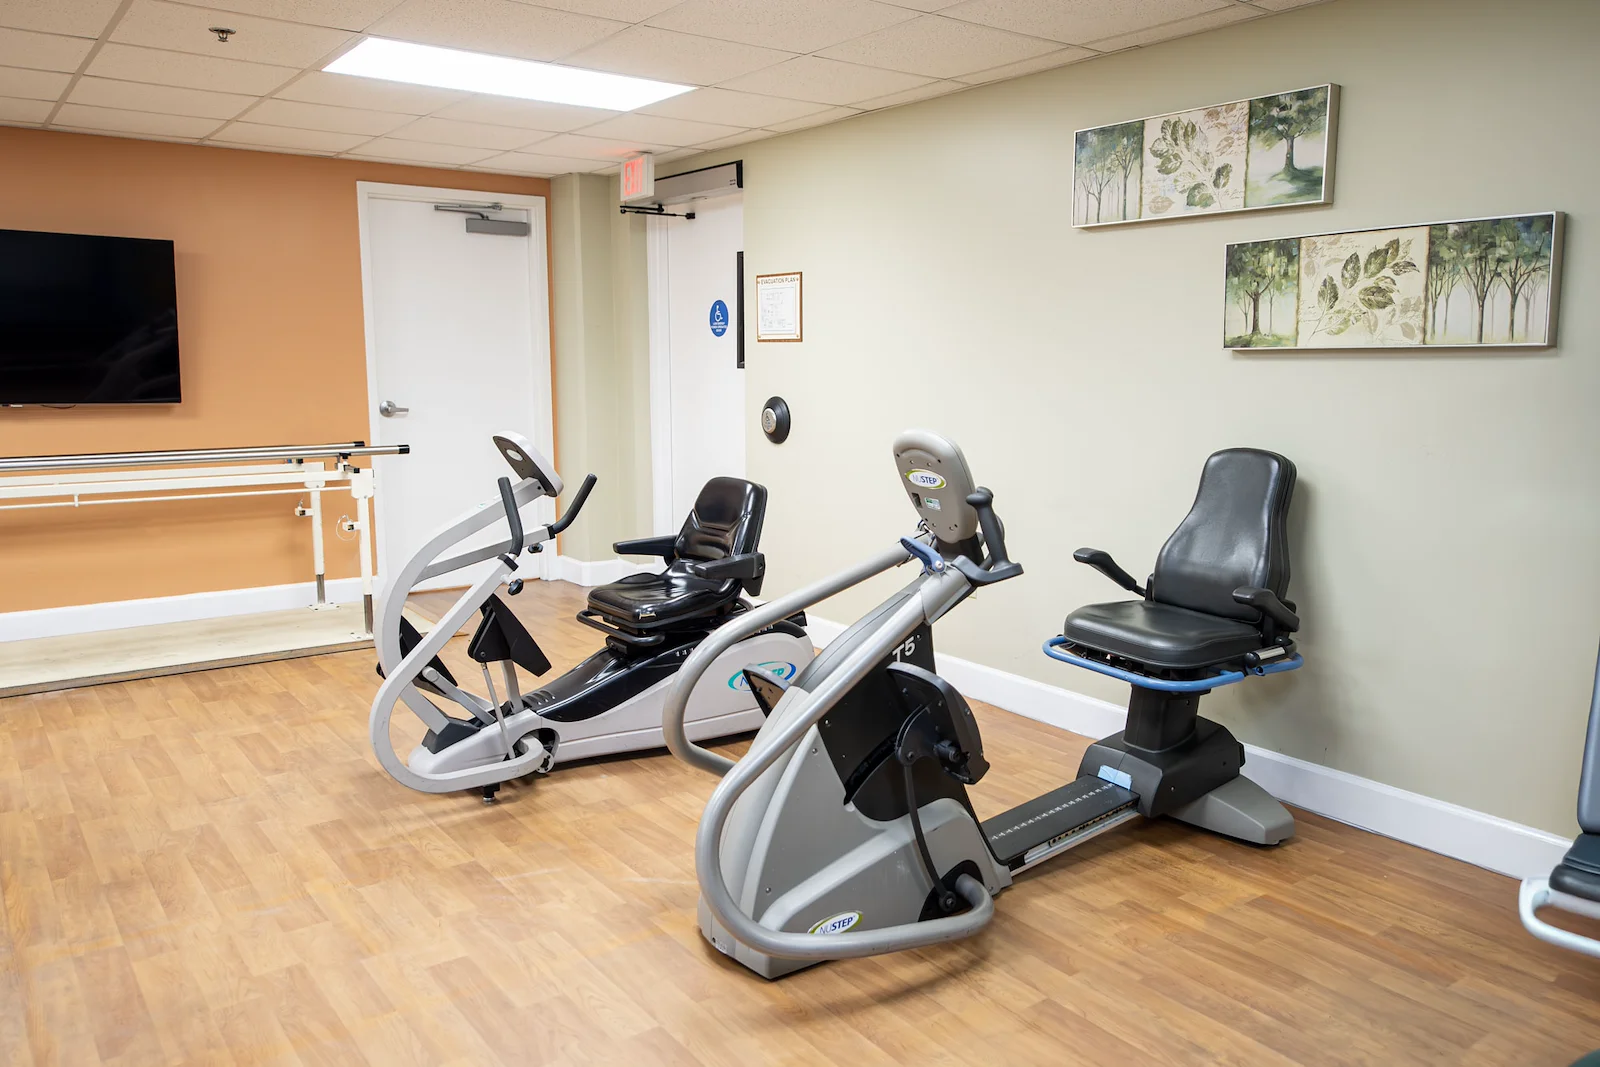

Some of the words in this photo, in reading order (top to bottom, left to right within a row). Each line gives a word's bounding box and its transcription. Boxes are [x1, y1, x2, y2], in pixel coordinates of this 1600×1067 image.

[624, 157, 644, 196] EXIT
[892, 636, 915, 662] T5
[820, 917, 853, 934] NUSTEP
